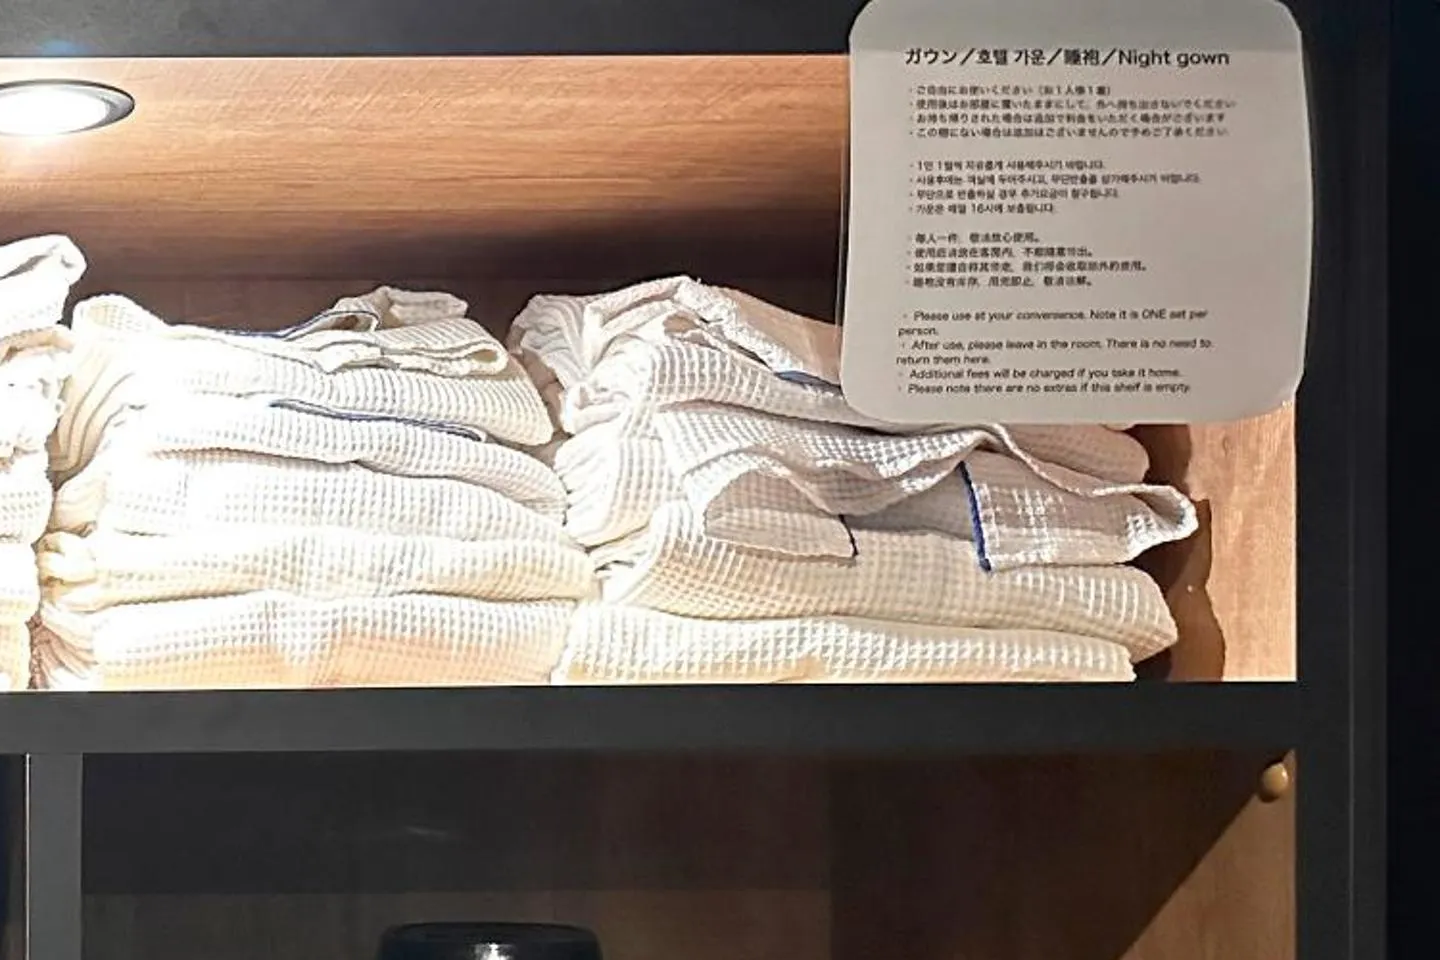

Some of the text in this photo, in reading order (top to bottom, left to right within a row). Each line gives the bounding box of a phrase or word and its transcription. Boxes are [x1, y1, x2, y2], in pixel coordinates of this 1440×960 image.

[1177, 52, 1230, 68] gown
[913, 311, 949, 321] Please
[952, 313, 972, 321] use
[974, 312, 985, 320] at
[989, 312, 1012, 322] your
[1090, 309, 1116, 320] Note
[1119, 309, 1127, 319] it
[1130, 309, 1138, 319] is
[1142, 309, 1166, 320] ONE
[1189, 310, 1208, 321] per
[898, 327, 939, 337] person.
[912, 340, 940, 350] After
[968, 340, 1003, 351] please
[1006, 340, 1034, 349] leave
[1037, 340, 1047, 349] in
[1050, 339, 1068, 349] the
[1107, 338, 1137, 348] There
[1140, 338, 1149, 348] is
[1152, 340, 1166, 348] no
[1169, 338, 1197, 349] need
[1200, 338, 1212, 348] to
[896, 355, 930, 364] return
[933, 355, 960, 364] them
[910, 369, 964, 379] Additional
[967, 369, 989, 379] fees
[994, 369, 1010, 378] will
[1013, 369, 1026, 378] be
[1029, 368, 1074, 380] charged
[1077, 368, 1086, 378] if
[1088, 369, 1109, 379] you
[1112, 368, 1135, 377] take
[1138, 368, 1145, 377] it
[908, 383, 943, 394] Please
[946, 384, 970, 393] note
[974, 383, 1002, 393] there
[1006, 385, 1023, 393] are
[1026, 385, 1041, 393] no
[1044, 384, 1077, 393] extras
[1080, 383, 1088, 392] if
[1092, 382, 1110, 392] this
[1114, 382, 1140, 392] shelf
[1143, 383, 1152, 392] is
